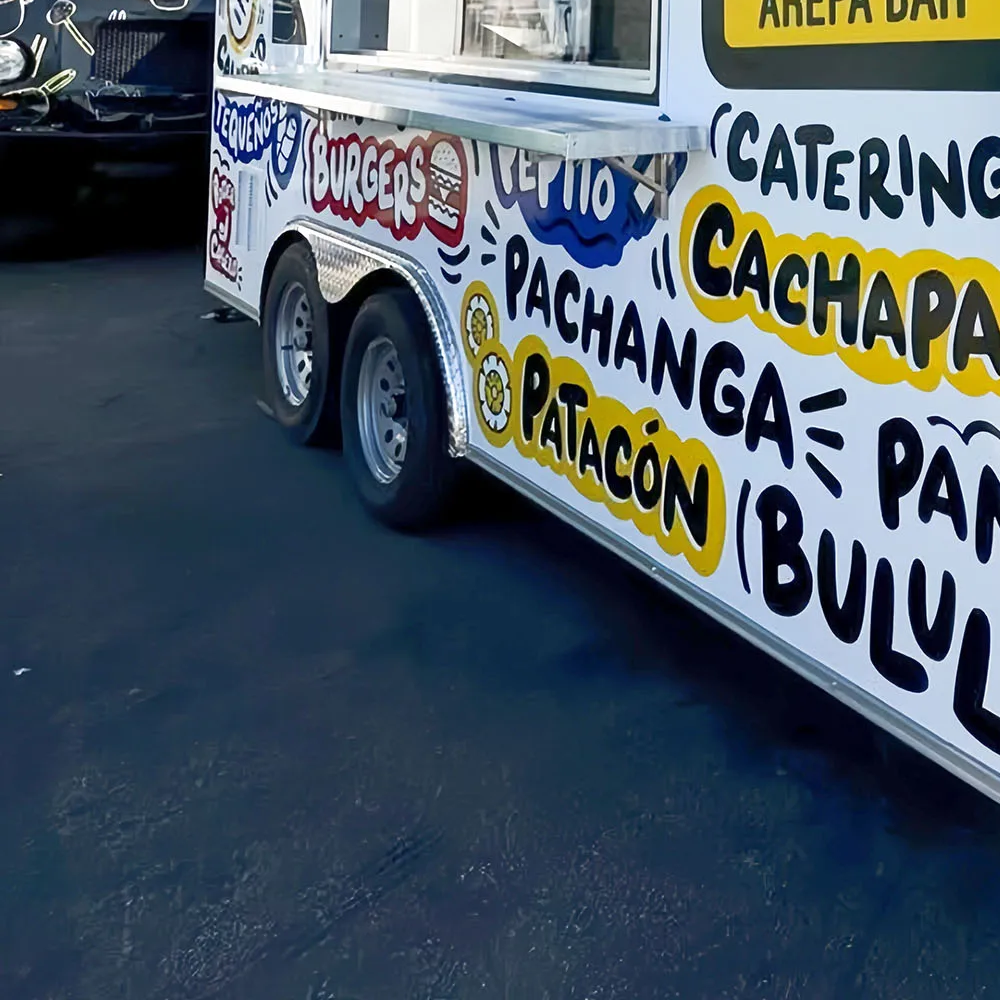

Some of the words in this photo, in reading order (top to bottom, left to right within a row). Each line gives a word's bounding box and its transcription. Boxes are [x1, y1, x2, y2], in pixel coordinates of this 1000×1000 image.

[312, 133, 426, 230] BURGERS
[505, 233, 794, 469] PACHANGA
[520, 352, 709, 547] PATACÓN
